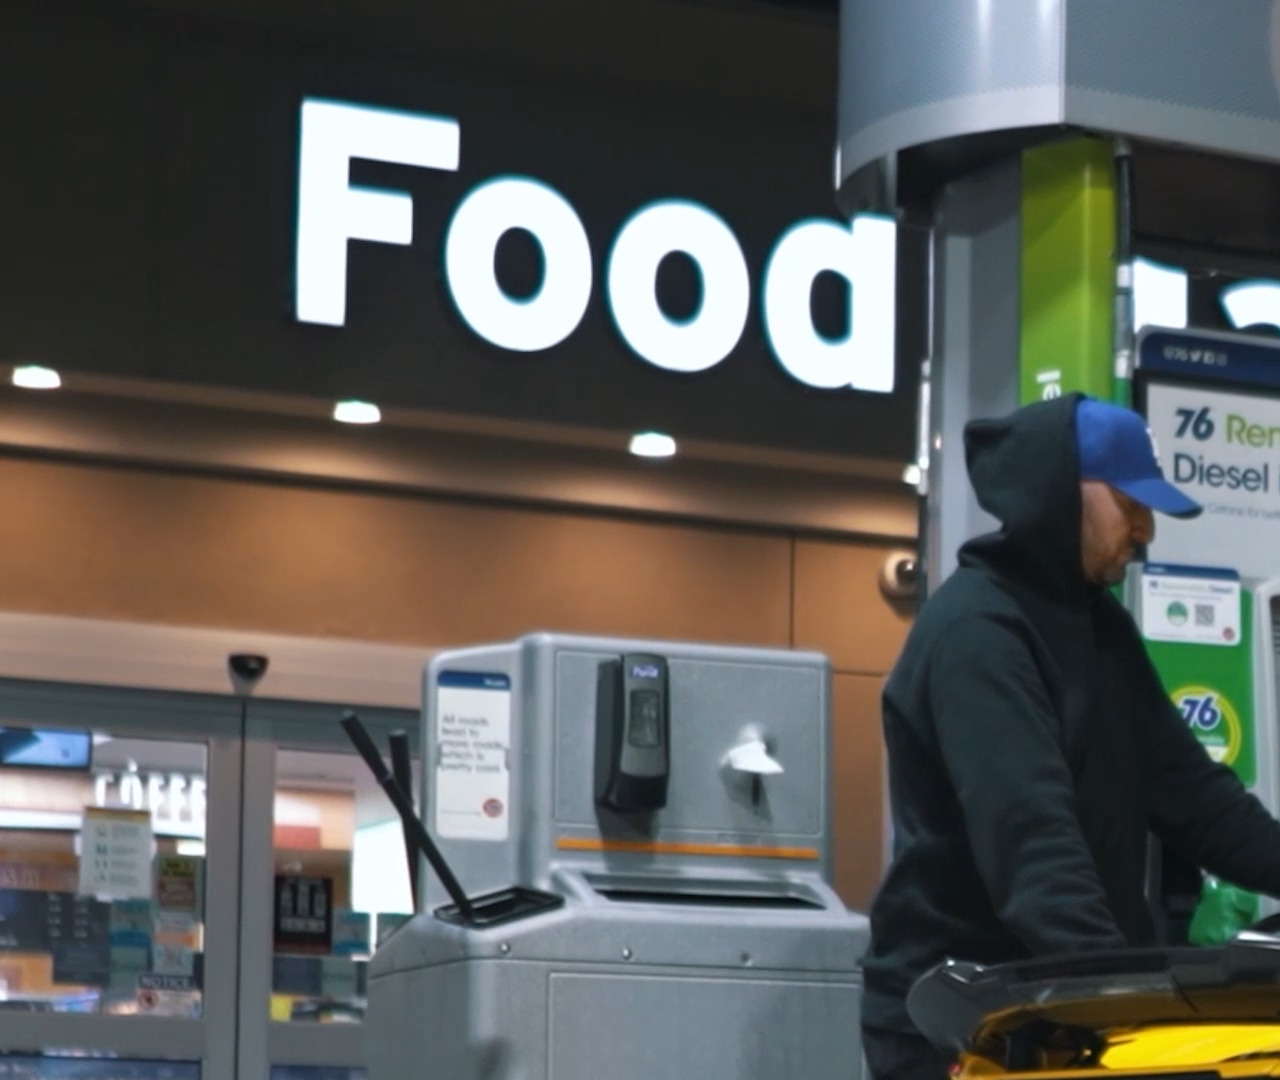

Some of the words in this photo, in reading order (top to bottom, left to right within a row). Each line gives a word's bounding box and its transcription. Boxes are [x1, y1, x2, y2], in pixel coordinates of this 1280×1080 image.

[297, 97, 896, 393] Food
[1174, 406, 1214, 441] 76
[1173, 453, 1269, 493] Diesel
[1180, 695, 1221, 731] 76
